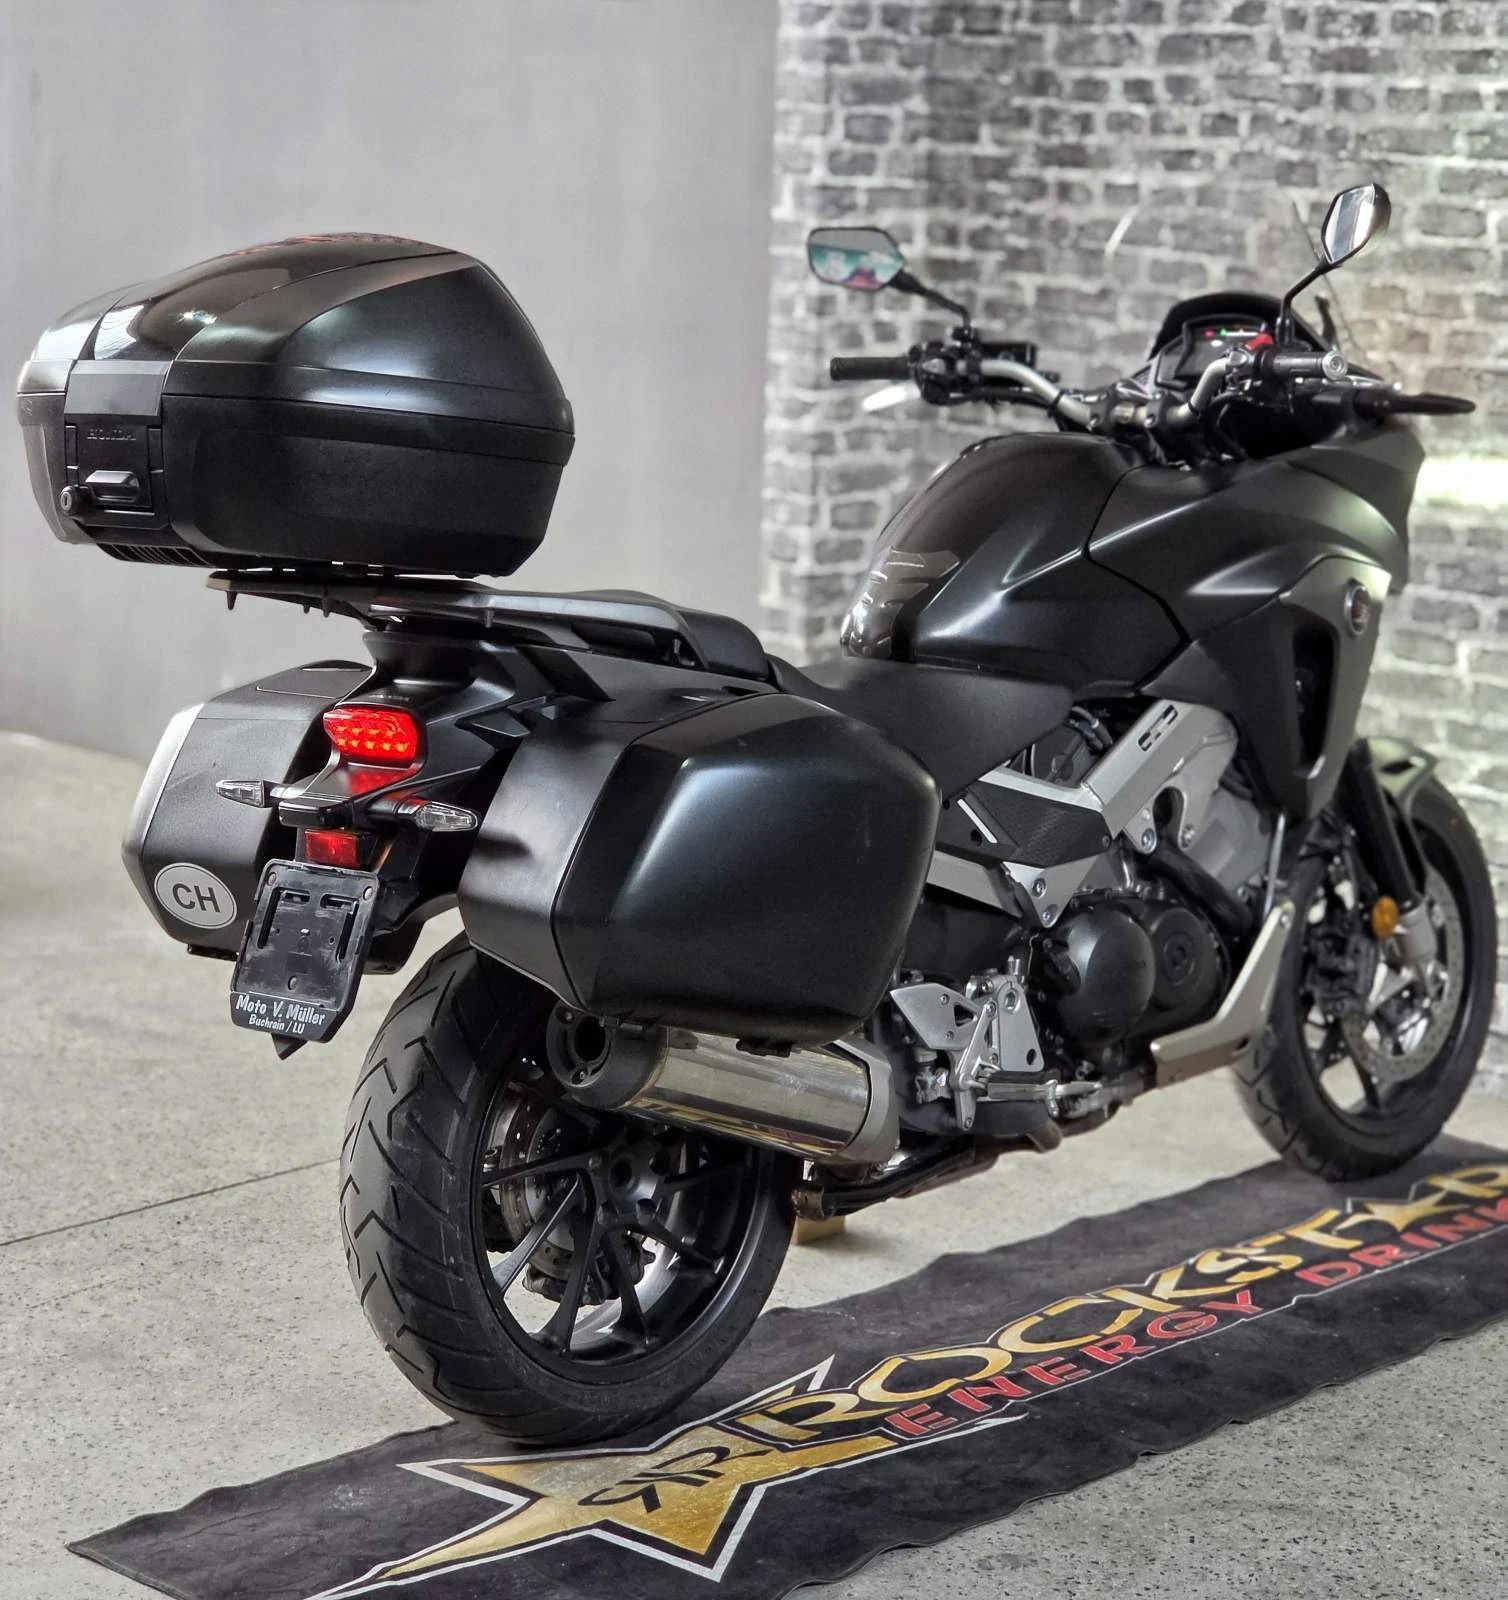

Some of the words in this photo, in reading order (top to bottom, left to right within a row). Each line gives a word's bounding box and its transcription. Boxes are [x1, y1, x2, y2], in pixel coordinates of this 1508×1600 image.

[172, 882, 221, 913] CH
[236, 994, 267, 1014] Moto
[273, 1001, 283, 1018] V.
[286, 1003, 326, 1025] Müller
[248, 1014, 285, 1031] Buchrain
[292, 1022, 306, 1034] LU
[884, 1289, 1263, 1437] ENERGY
